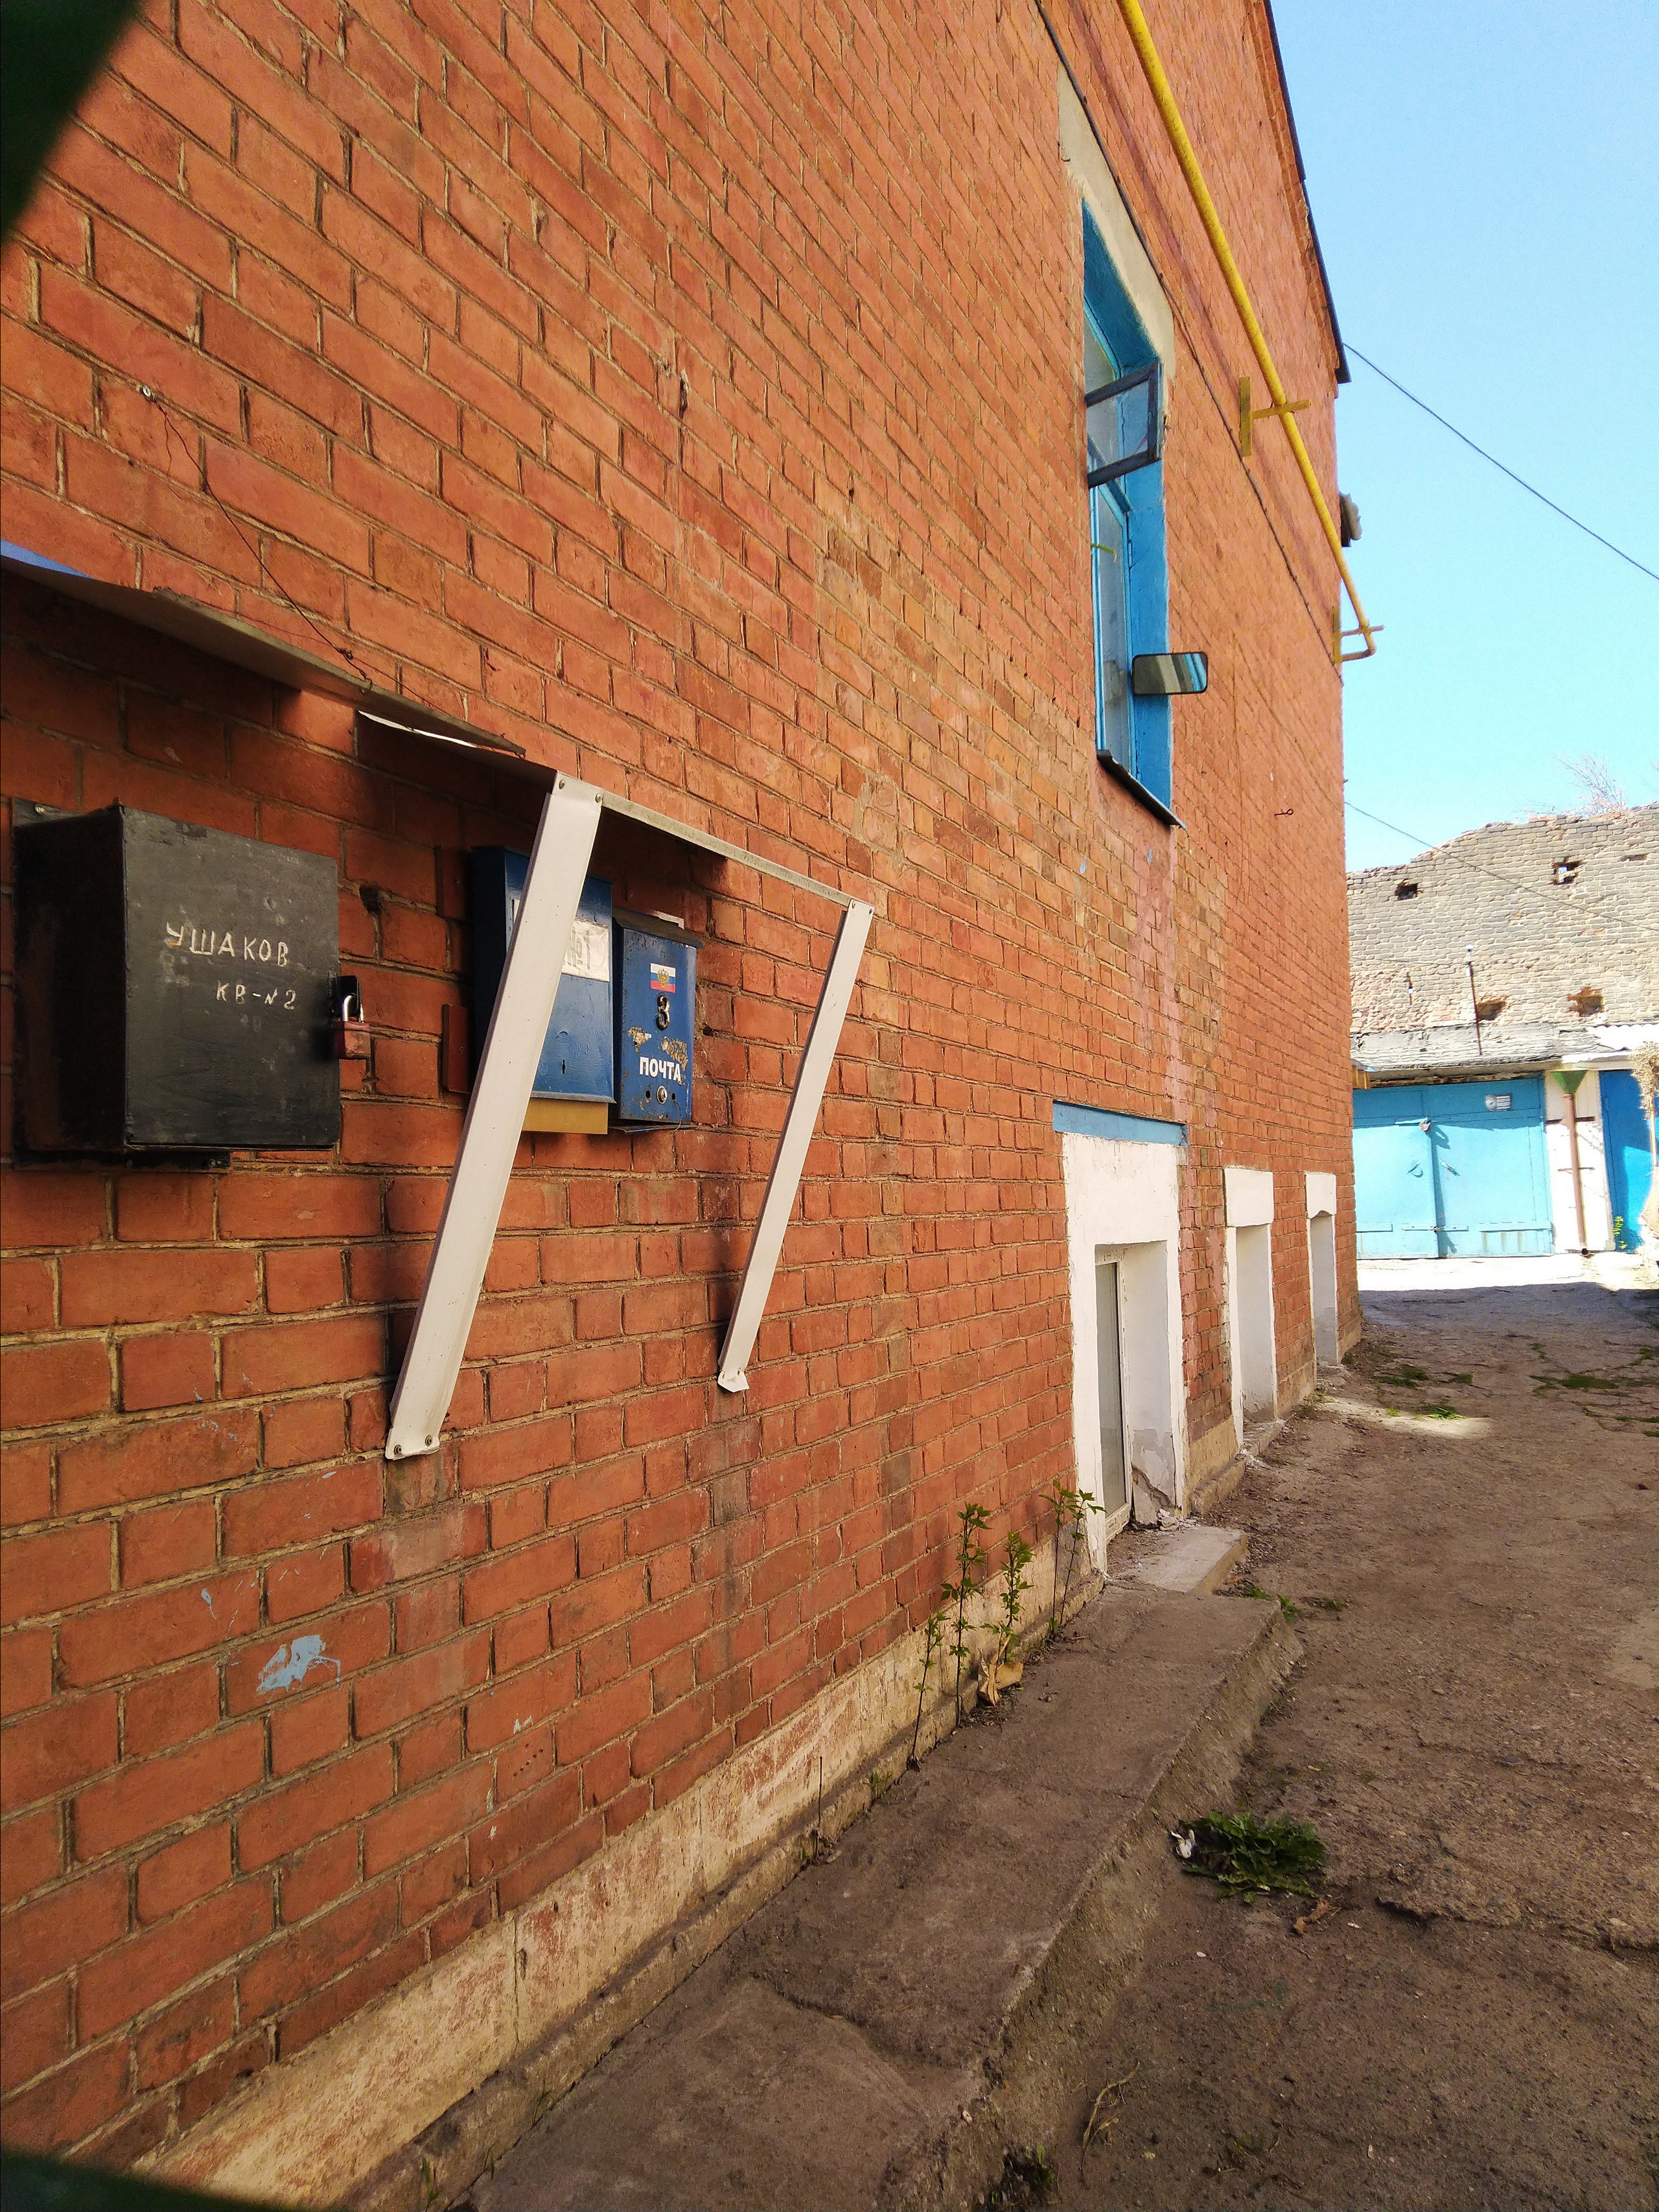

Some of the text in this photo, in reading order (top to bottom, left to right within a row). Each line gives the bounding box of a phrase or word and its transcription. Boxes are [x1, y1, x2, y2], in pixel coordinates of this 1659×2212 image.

[167, 922, 289, 967] УШАКОВ
[656, 994, 670, 1030] 3
[639, 1056, 681, 1082] ПОЧТА
